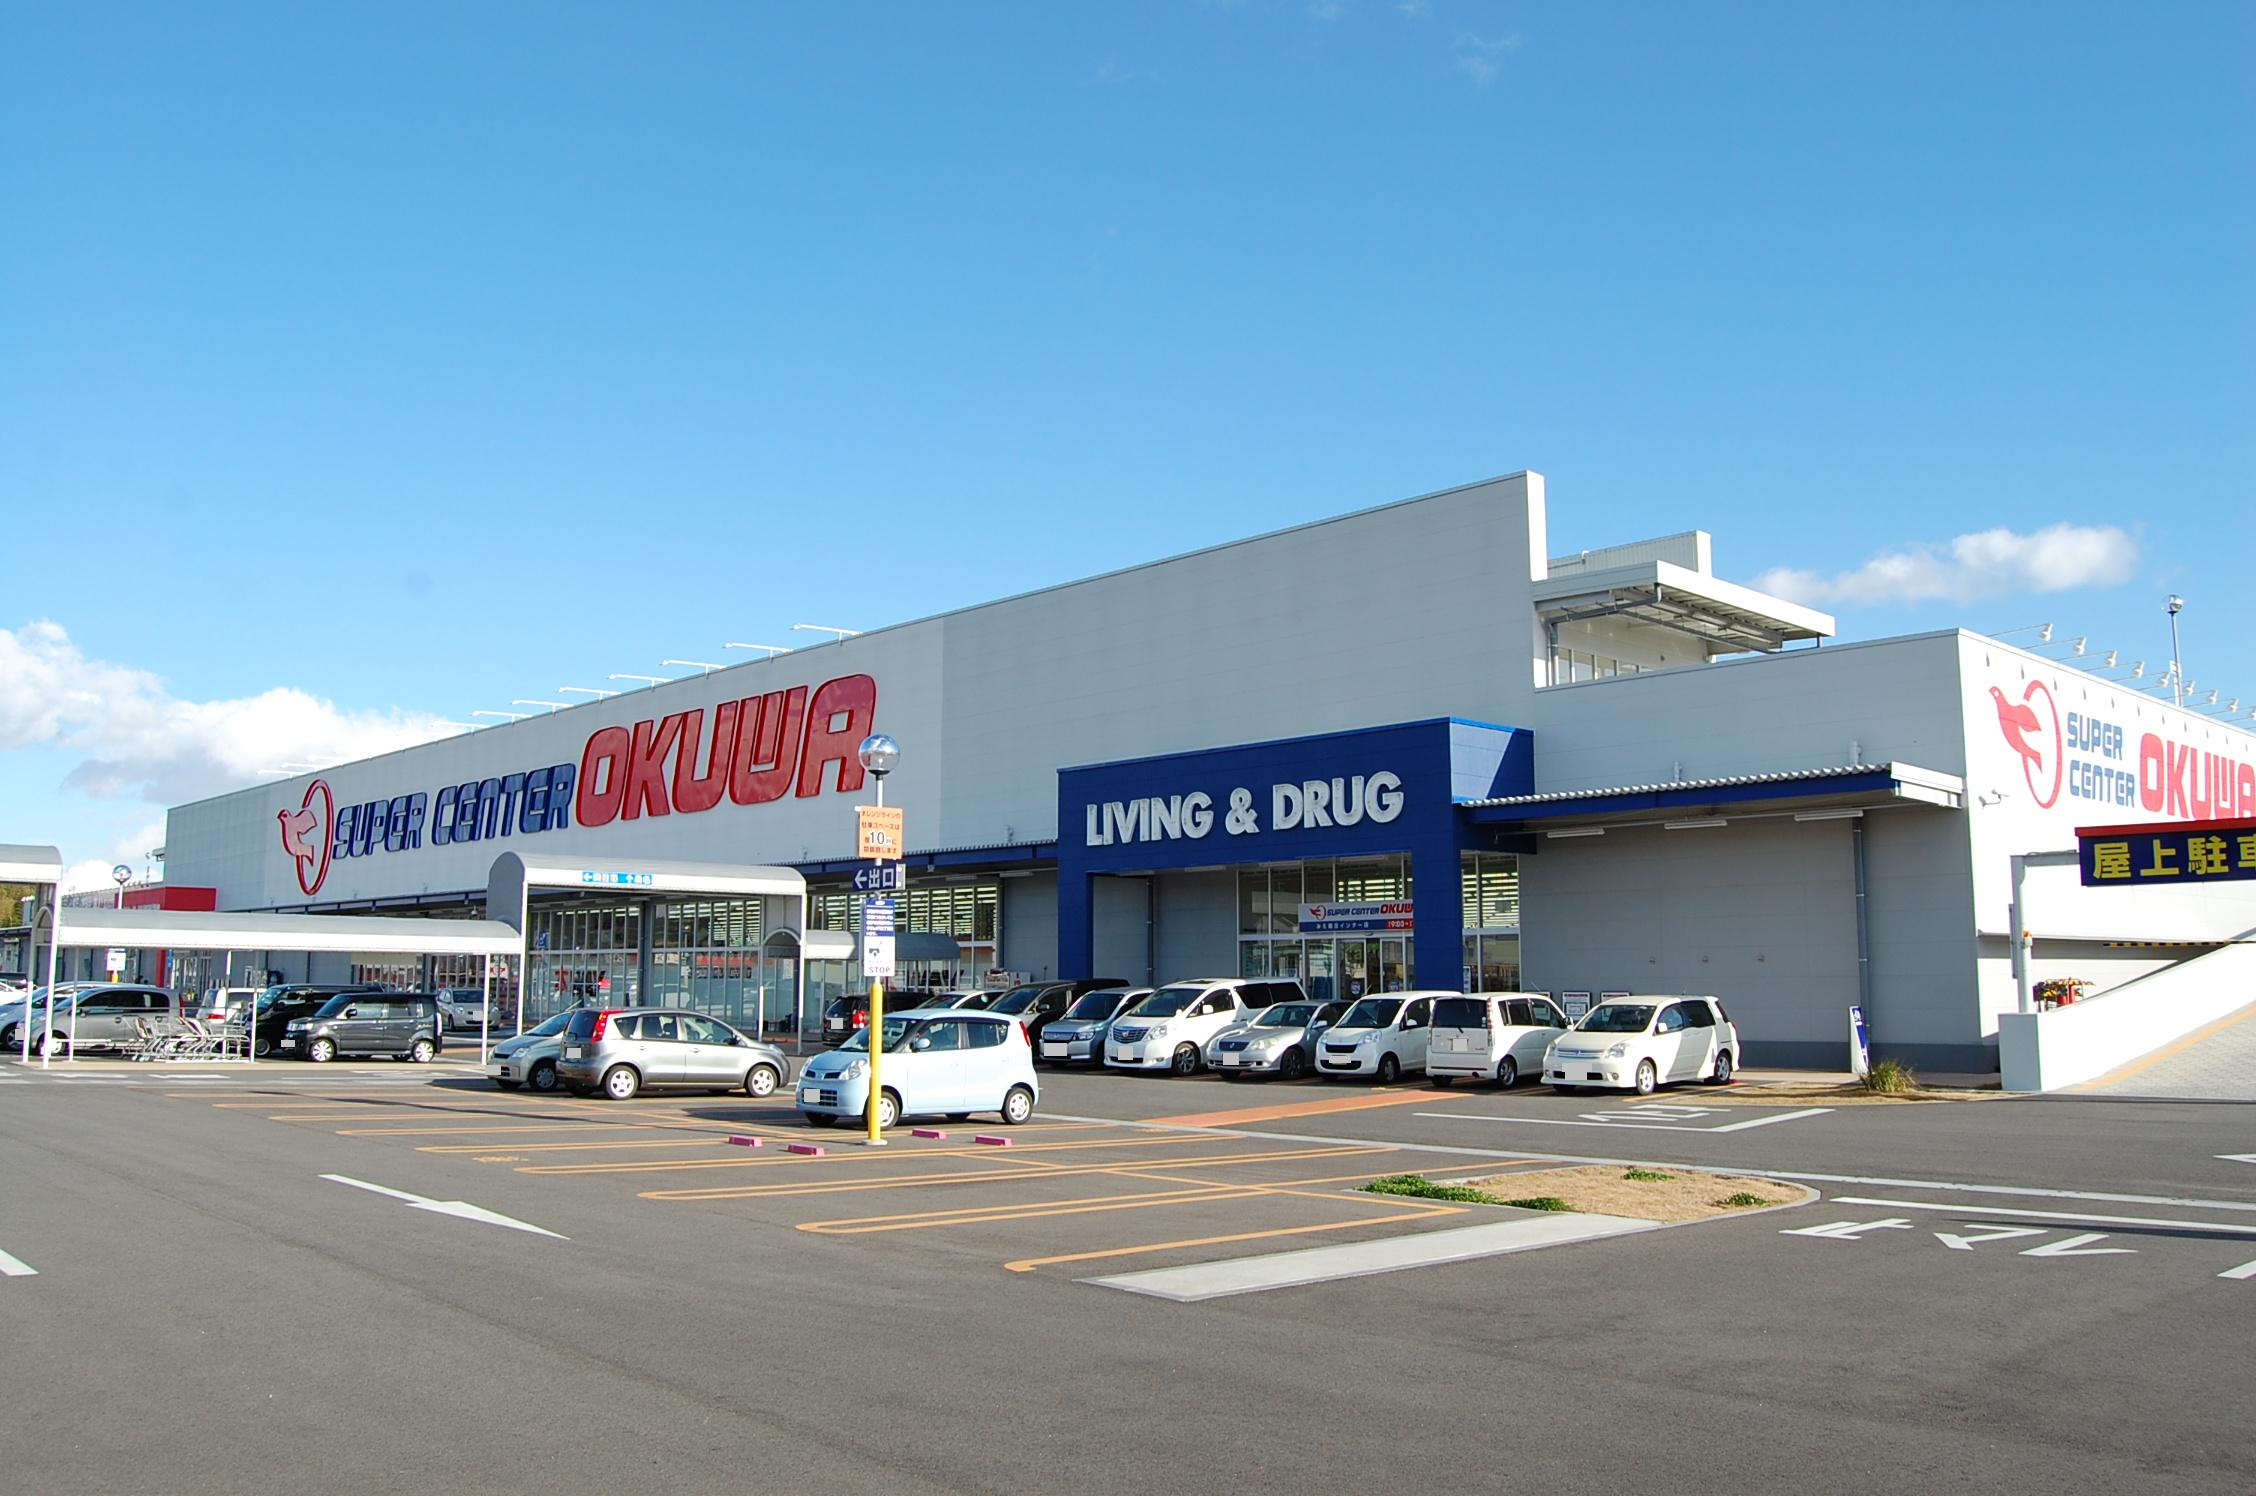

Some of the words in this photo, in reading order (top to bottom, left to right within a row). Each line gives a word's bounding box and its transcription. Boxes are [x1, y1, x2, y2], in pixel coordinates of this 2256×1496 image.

[2067, 711, 2123, 761] SUPER
[333, 792, 427, 859] SUPER
[432, 763, 576, 845] CENTER
[575, 673, 877, 828] OKUWA
[2069, 759, 2135, 808] CENTER
[1086, 791, 1214, 846] LIVING
[1225, 787, 1259, 835] &
[1272, 770, 1405, 830] DRUG
[868, 868, 895, 889] 出口
[1327, 908, 1350, 917] SUPER
[1350, 906, 1379, 916] CENTER
[868, 966, 891, 974] STOP
